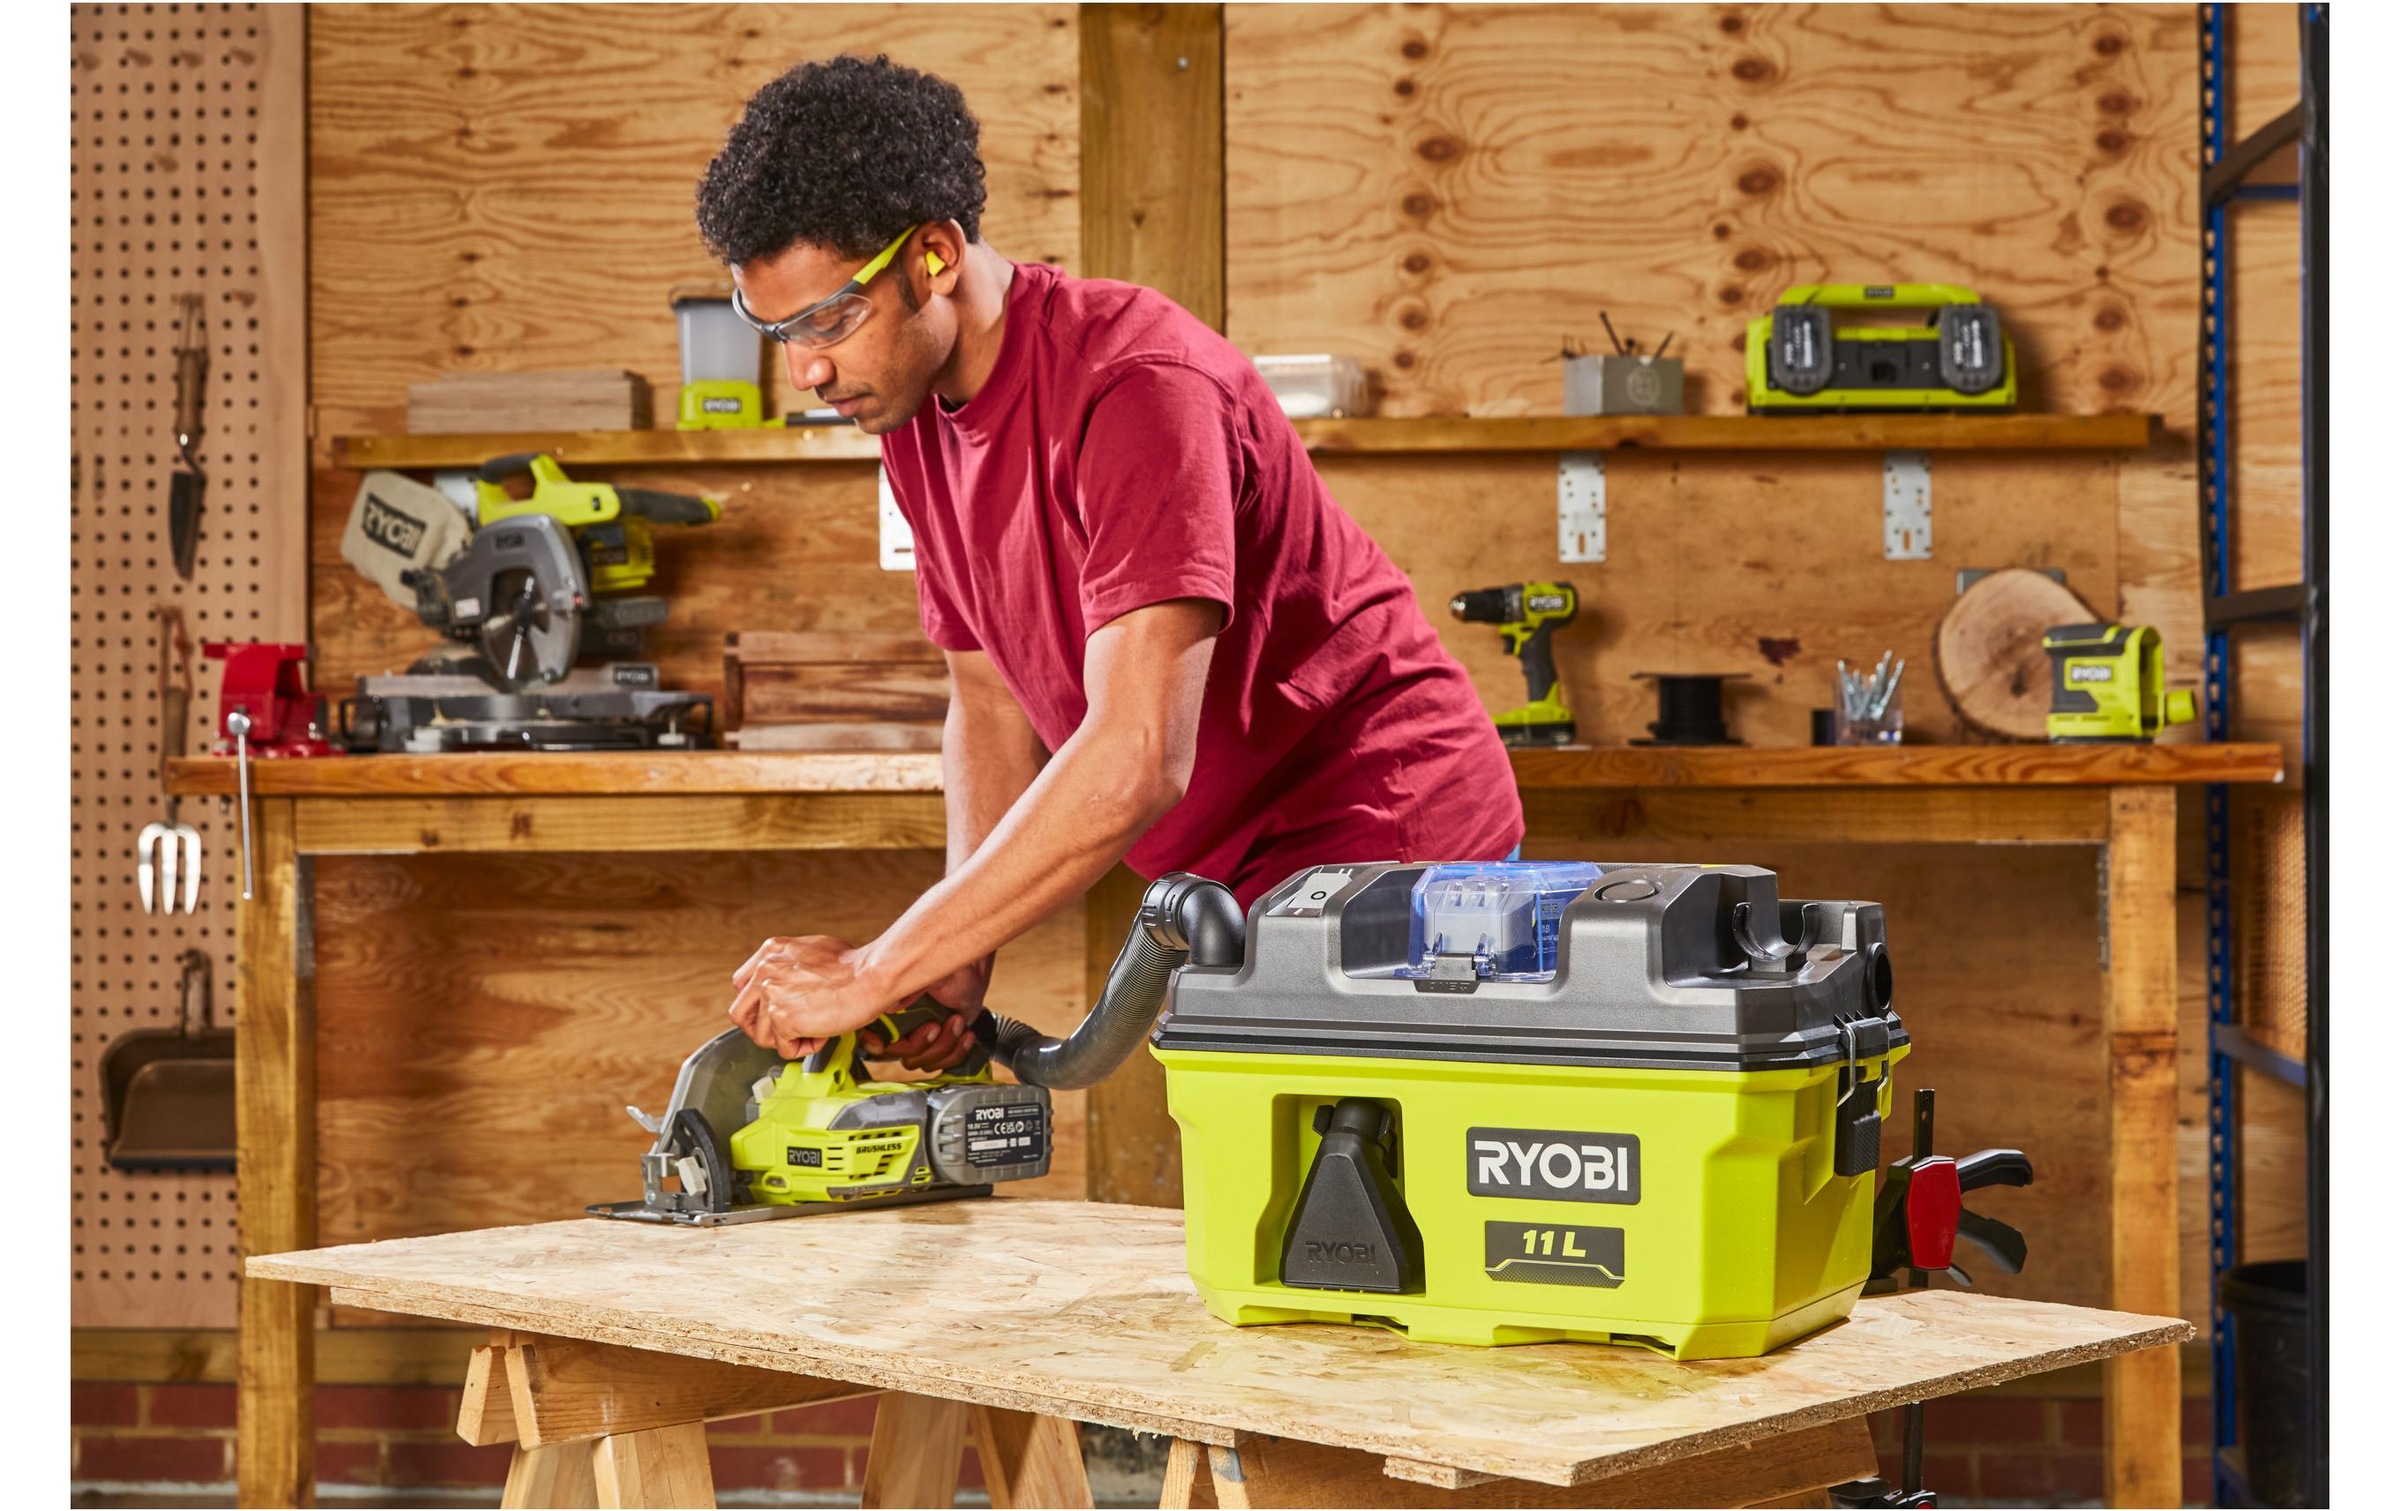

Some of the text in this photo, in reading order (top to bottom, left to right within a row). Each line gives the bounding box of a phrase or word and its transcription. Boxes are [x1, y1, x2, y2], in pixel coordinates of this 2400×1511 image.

[366, 502, 420, 551] RYOBI
[2071, 666, 2112, 681] RYOBI
[975, 1107, 1004, 1120] RYOBI
[788, 1149, 820, 1165] RYOBI
[856, 1143, 902, 1154] BRUSHLESS
[1474, 1140, 1628, 1191] RYOBI
[1523, 1229, 1587, 1257] 11 L
[1305, 1241, 1377, 1266] RYOBI
